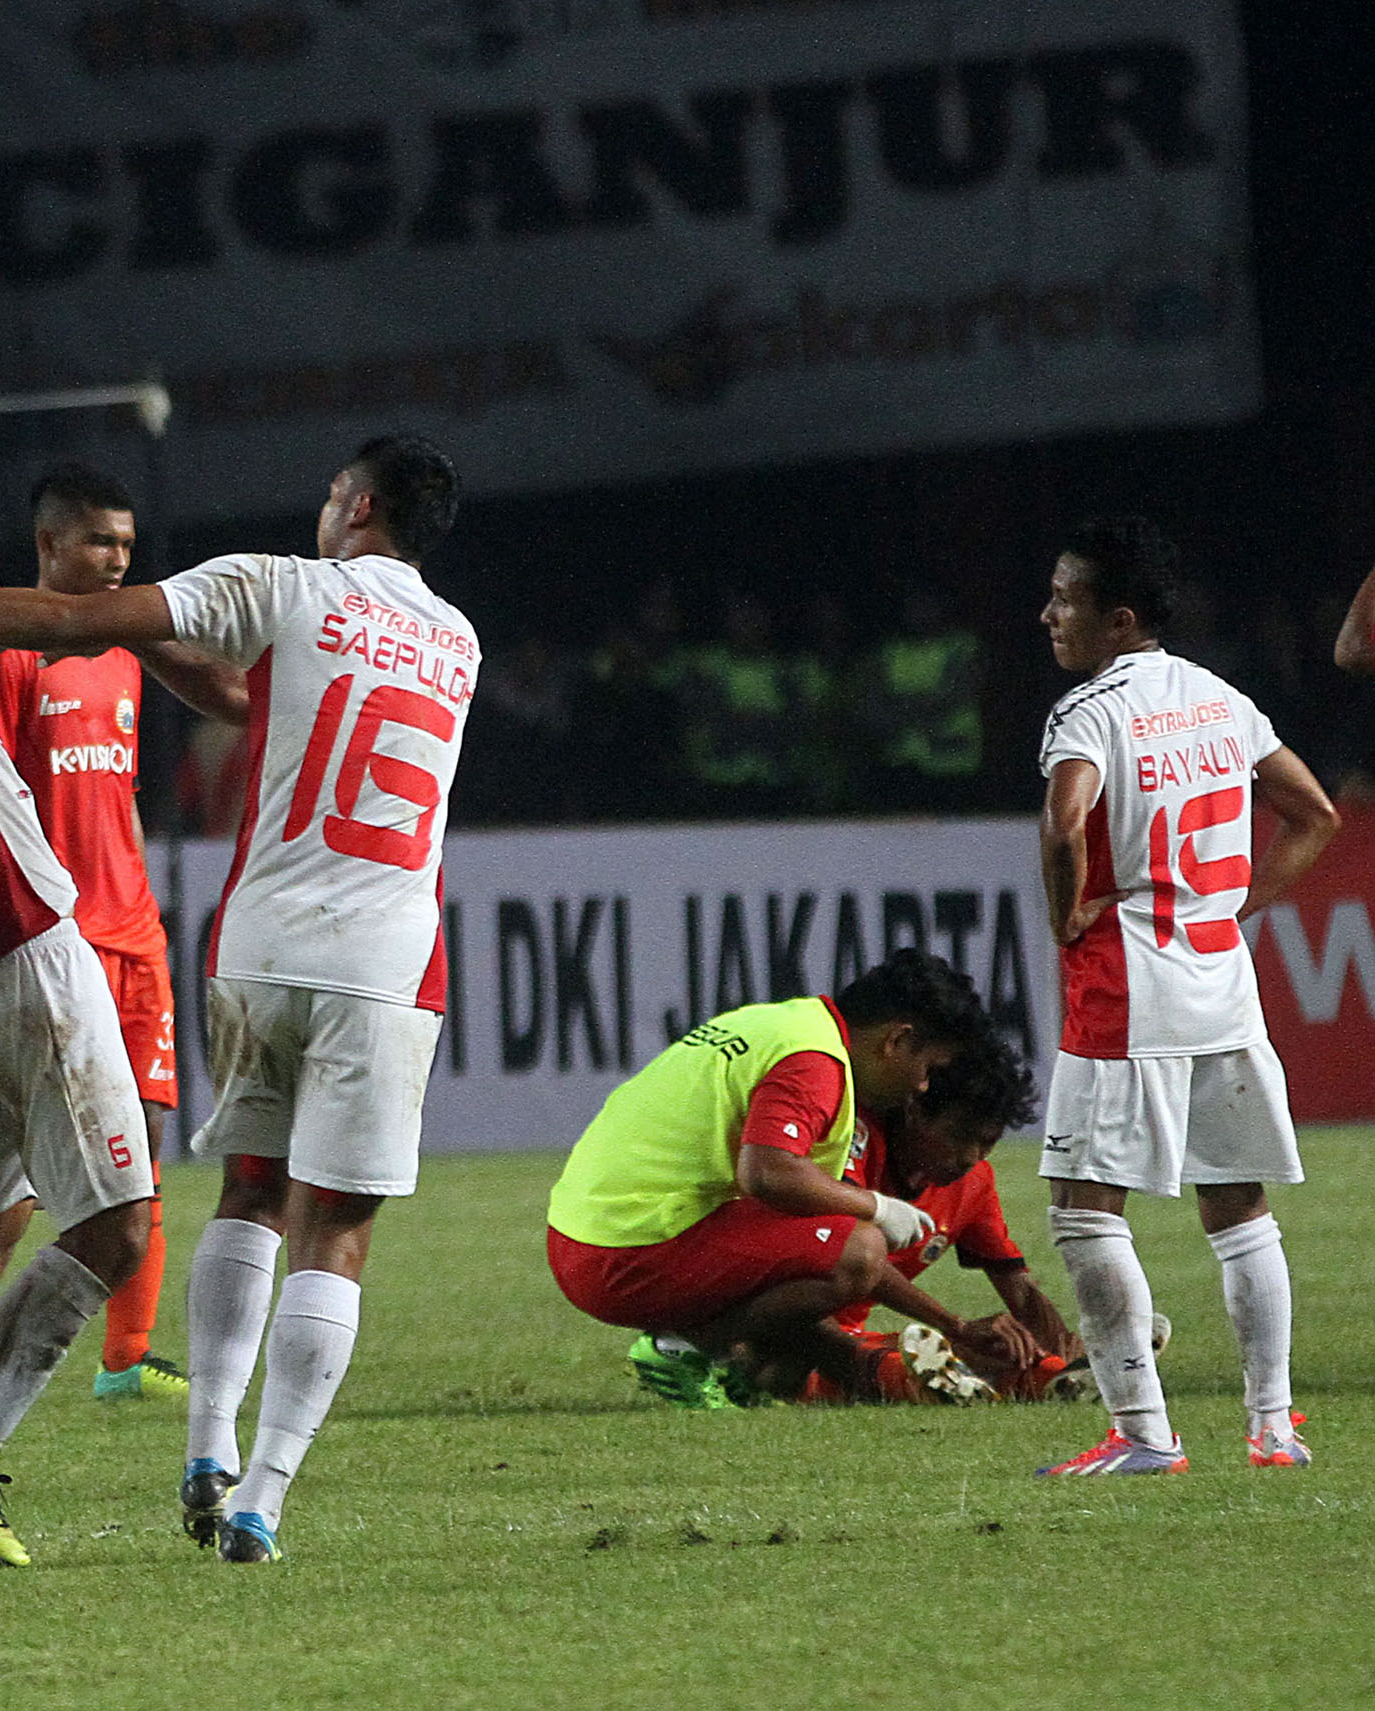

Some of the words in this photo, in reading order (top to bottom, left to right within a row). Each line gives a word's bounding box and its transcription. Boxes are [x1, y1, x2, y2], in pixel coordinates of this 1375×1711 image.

[343, 593, 421, 640] EXTRA
[425, 624, 474, 661] JOSS
[282, 673, 456, 872] 16
[1148, 785, 1252, 955] 15
[498, 892, 631, 1073] DKI
[107, 1133, 133, 1169] 6
